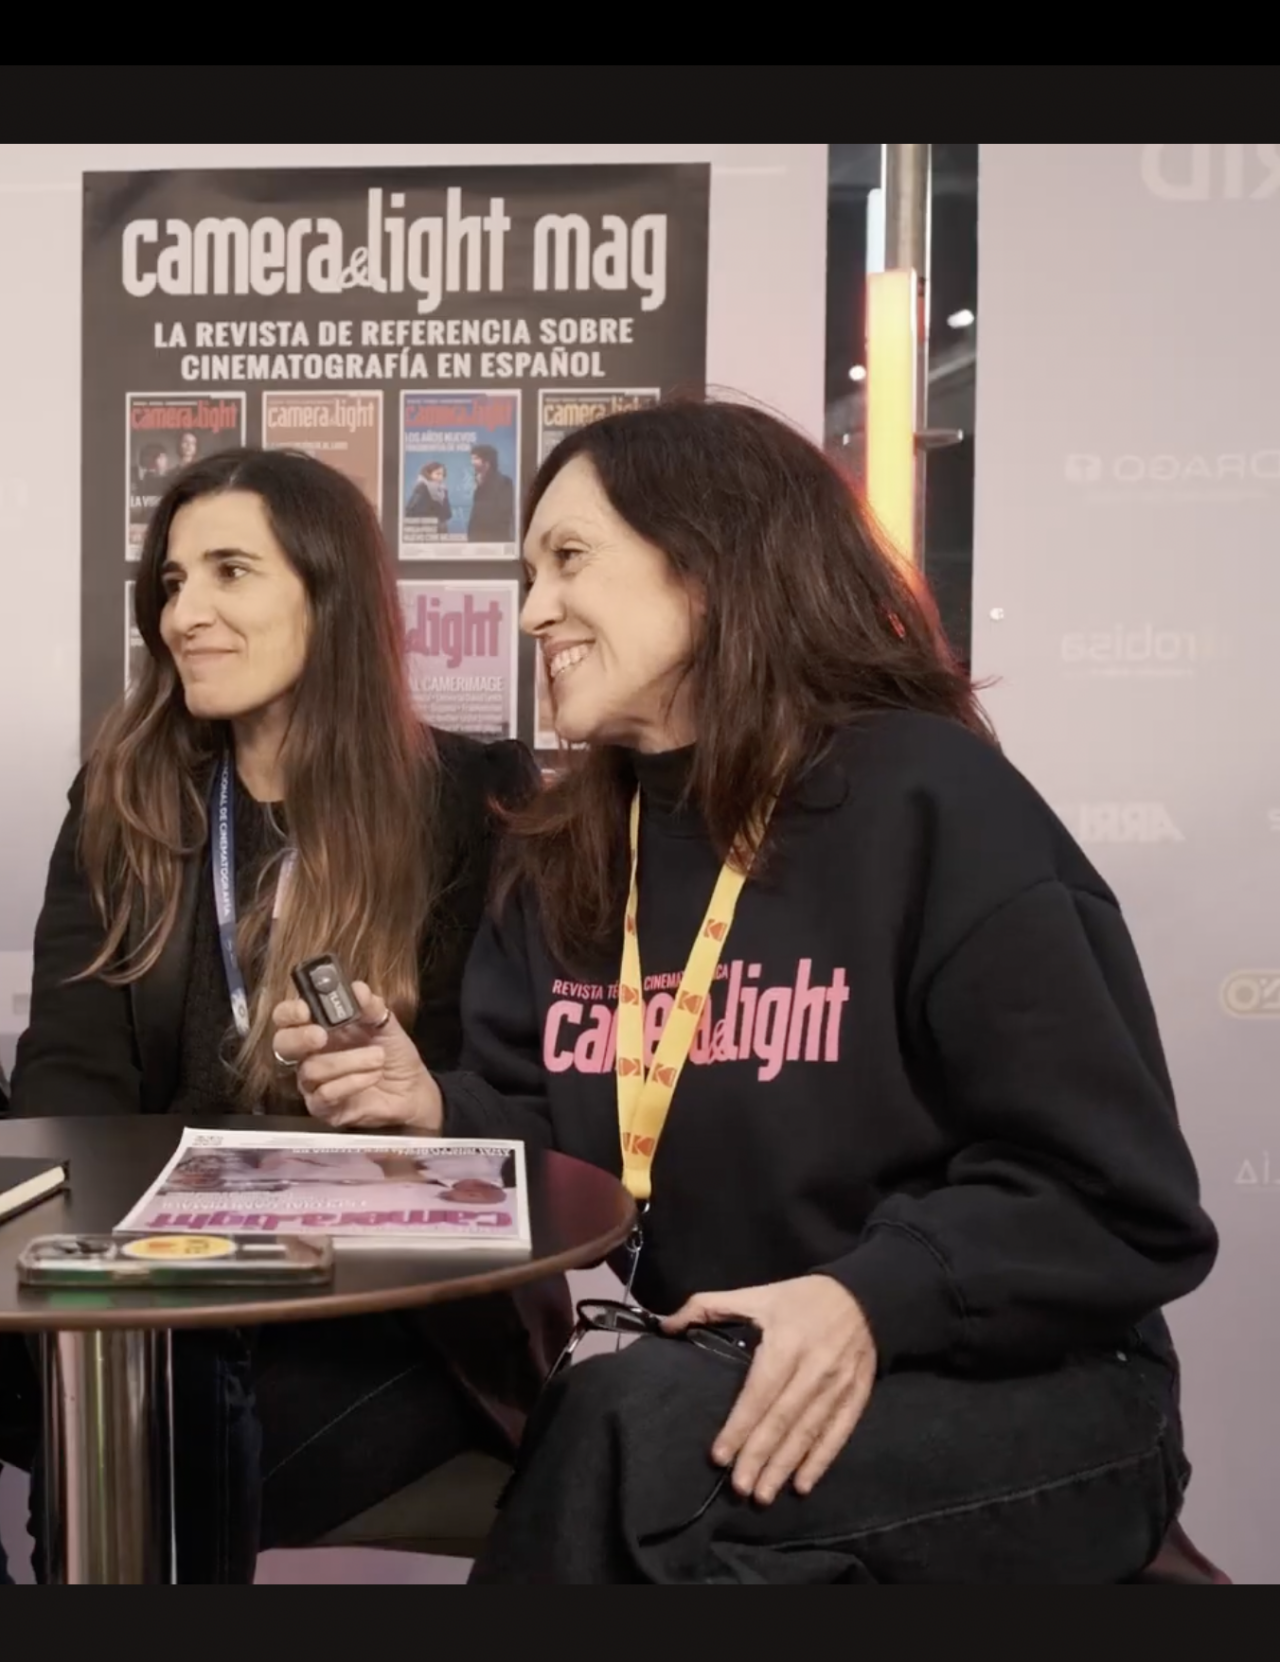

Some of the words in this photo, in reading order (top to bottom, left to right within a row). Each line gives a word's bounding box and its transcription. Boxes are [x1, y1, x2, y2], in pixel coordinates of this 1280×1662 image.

[122, 187, 511, 313] camera&light
[533, 214, 667, 311] mag
[154, 322, 187, 348] LA
[196, 321, 310, 347] REVISTA
[319, 320, 353, 346] DE
[361, 319, 531, 346] REFERENCIA
[539, 318, 634, 344] SOBRE
[181, 347, 429, 380] CINEMATOGRAFÍA
[437, 352, 471, 378] EN
[480, 346, 606, 377] ESPAÑOL
[552, 979, 603, 1000] REVISTA
